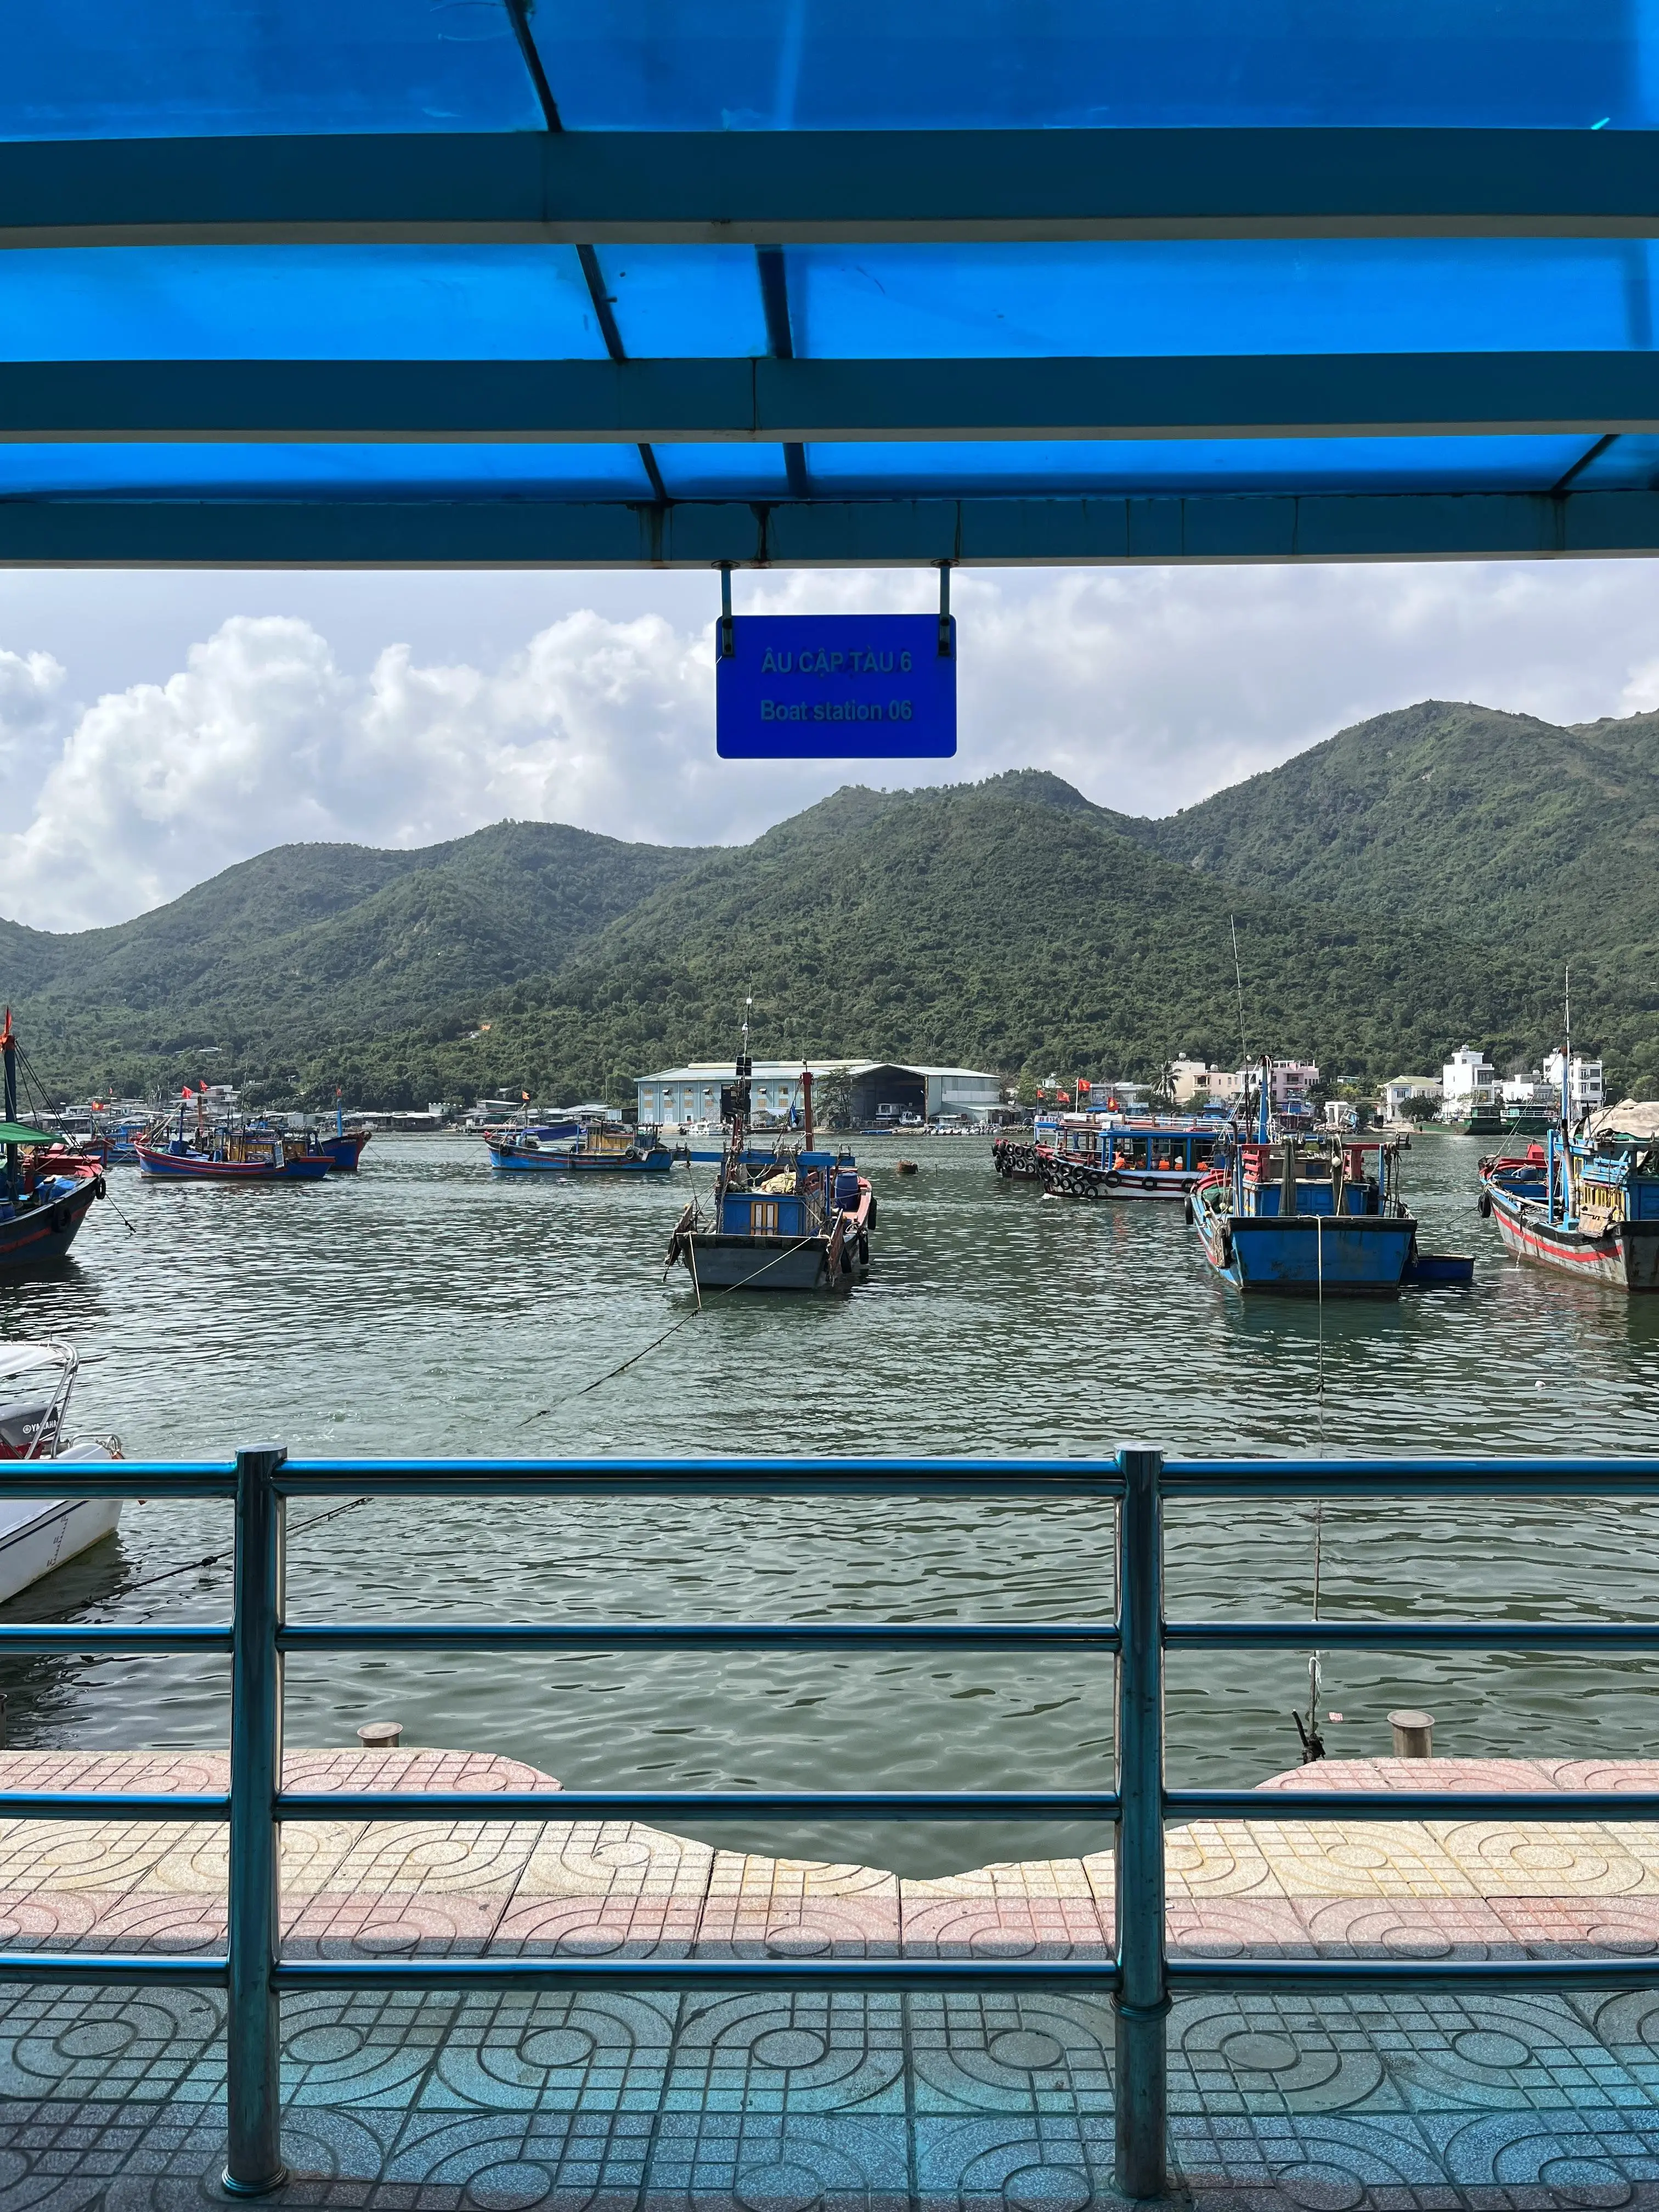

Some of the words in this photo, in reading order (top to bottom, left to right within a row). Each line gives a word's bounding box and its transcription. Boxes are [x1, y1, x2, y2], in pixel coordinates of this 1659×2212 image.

[761, 647, 792, 673] ÂU
[799, 648, 843, 677] CẬP
[850, 646, 893, 672] TÀU
[900, 652, 912, 672] 6
[761, 700, 808, 720] Boat
[814, 699, 882, 720] station
[889, 700, 912, 720] 06
